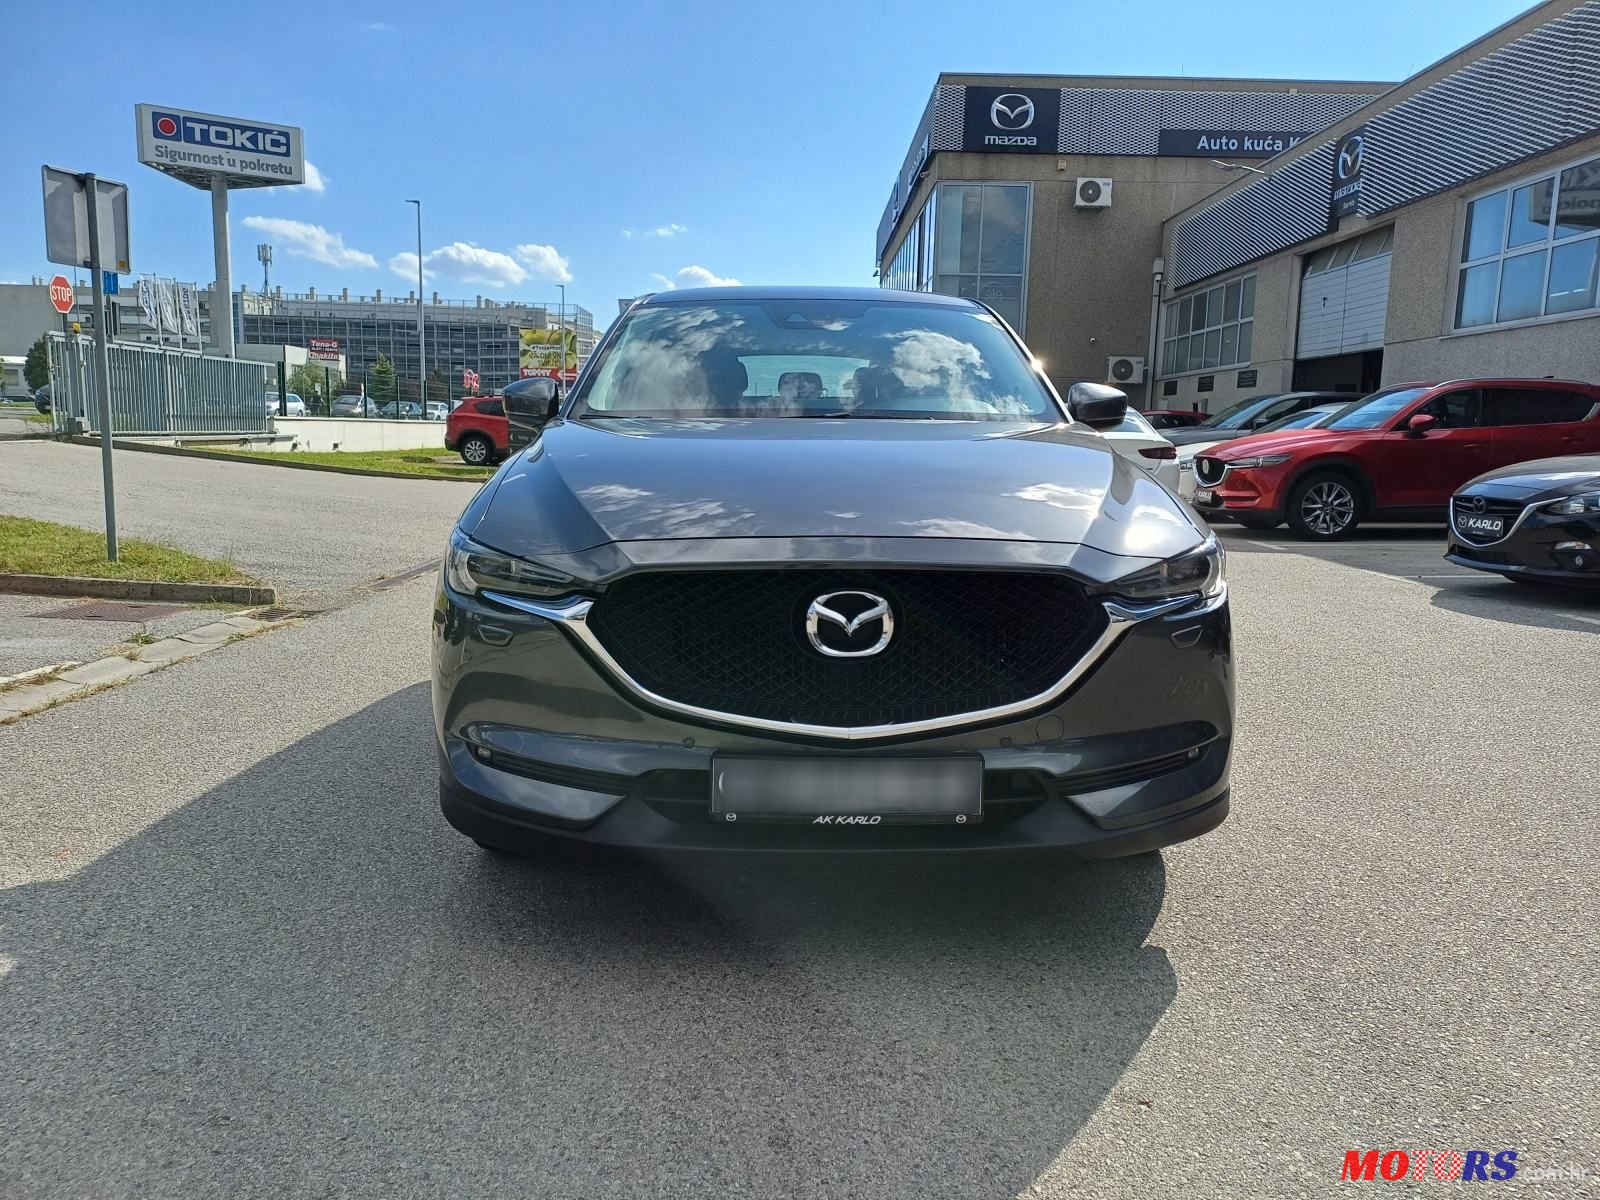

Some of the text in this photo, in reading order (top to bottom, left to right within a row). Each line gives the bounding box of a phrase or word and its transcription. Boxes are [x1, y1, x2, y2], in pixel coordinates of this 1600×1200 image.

[185, 121, 288, 154] TOKIĆ
[984, 135, 1037, 146] mazda
[1197, 135, 1239, 150] Auto
[1243, 135, 1283, 151] kuća
[154, 144, 293, 176] Sigurnost u pokretu
[51, 285, 72, 303] STOP
[1468, 517, 1502, 531] KARLO
[812, 815, 882, 825] AK KARLO
